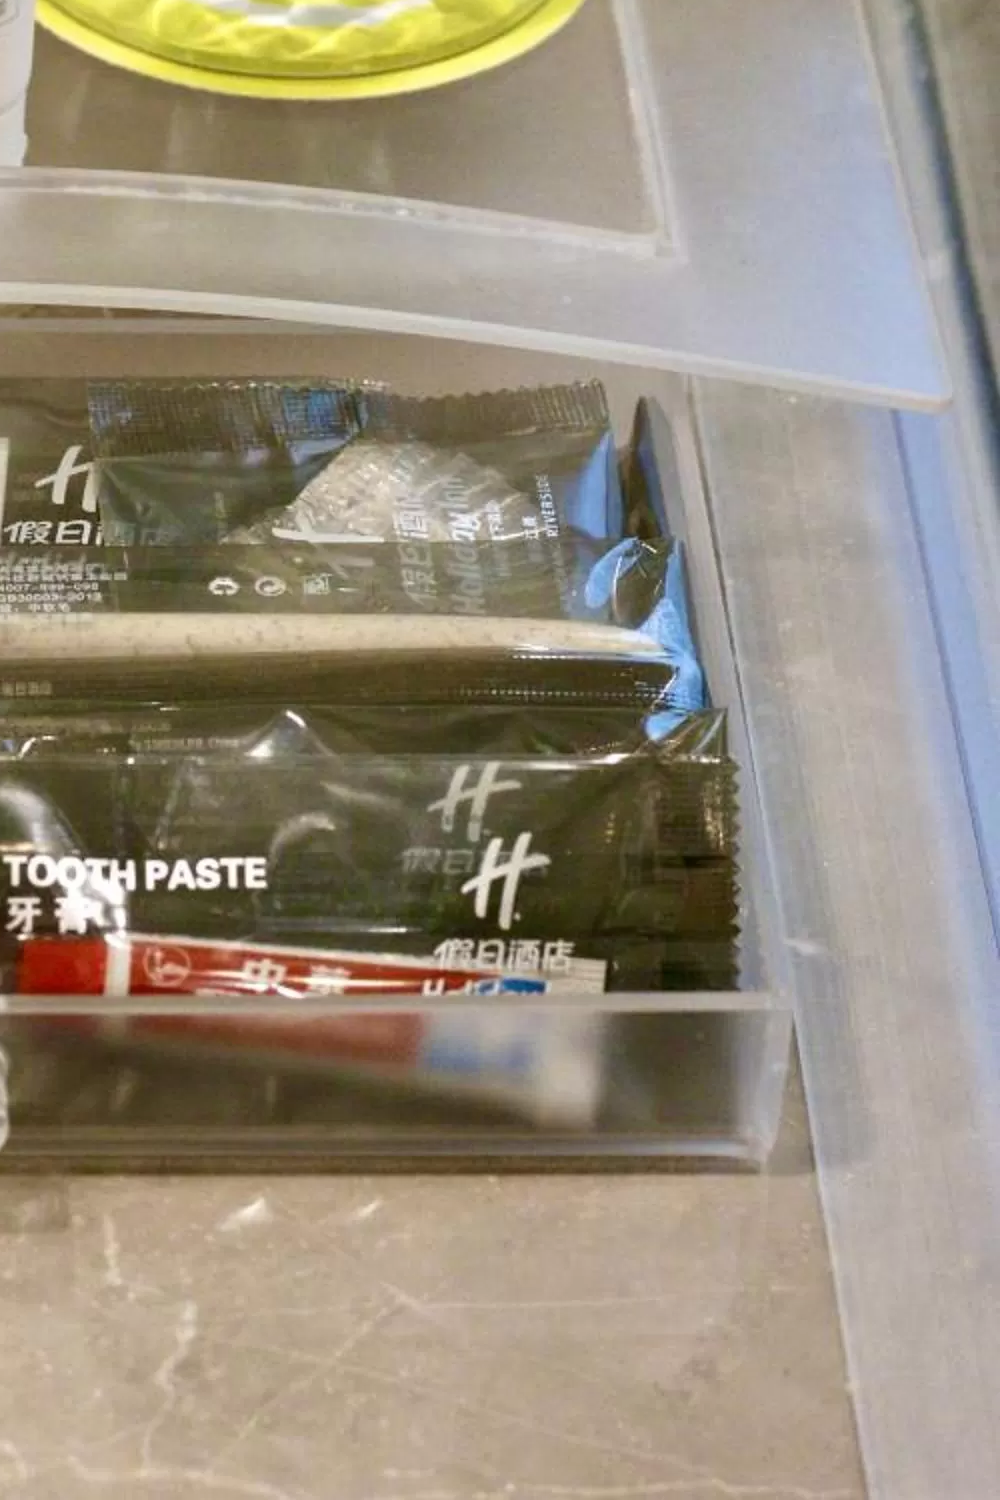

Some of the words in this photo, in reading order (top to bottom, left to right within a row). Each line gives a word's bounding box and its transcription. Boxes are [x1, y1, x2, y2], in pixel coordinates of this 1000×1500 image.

[2, 854, 137, 891] TOOTH
[145, 856, 268, 891] PASTE
[434, 937, 576, 974] 假日酒店
